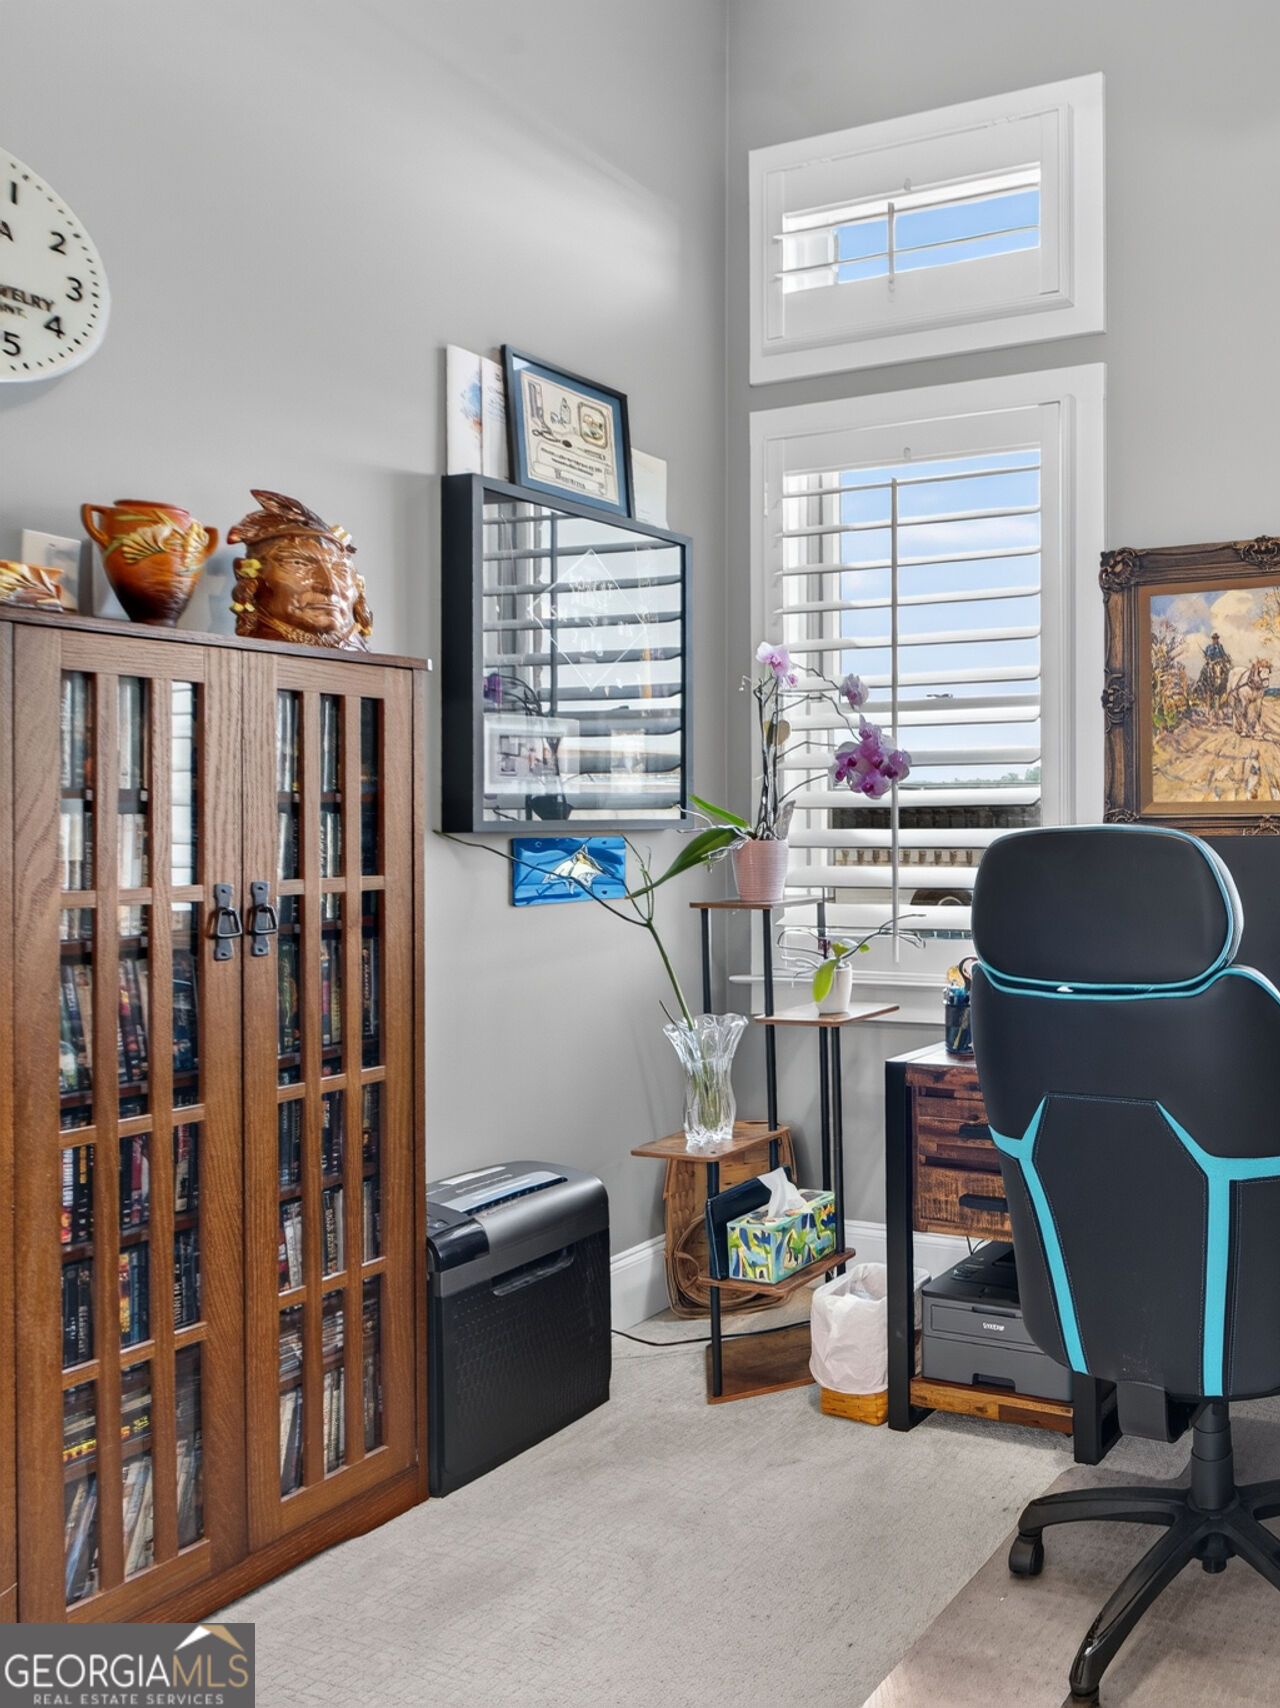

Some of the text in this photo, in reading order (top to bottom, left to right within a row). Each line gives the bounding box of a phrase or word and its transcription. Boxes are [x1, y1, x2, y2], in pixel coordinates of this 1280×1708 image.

[10, 181, 18, 205] 1
[50, 231, 67, 256] 2
[66, 276, 83, 302] 3
[43, 315, 66, 340] 4
[2, 331, 22, 357] 5
